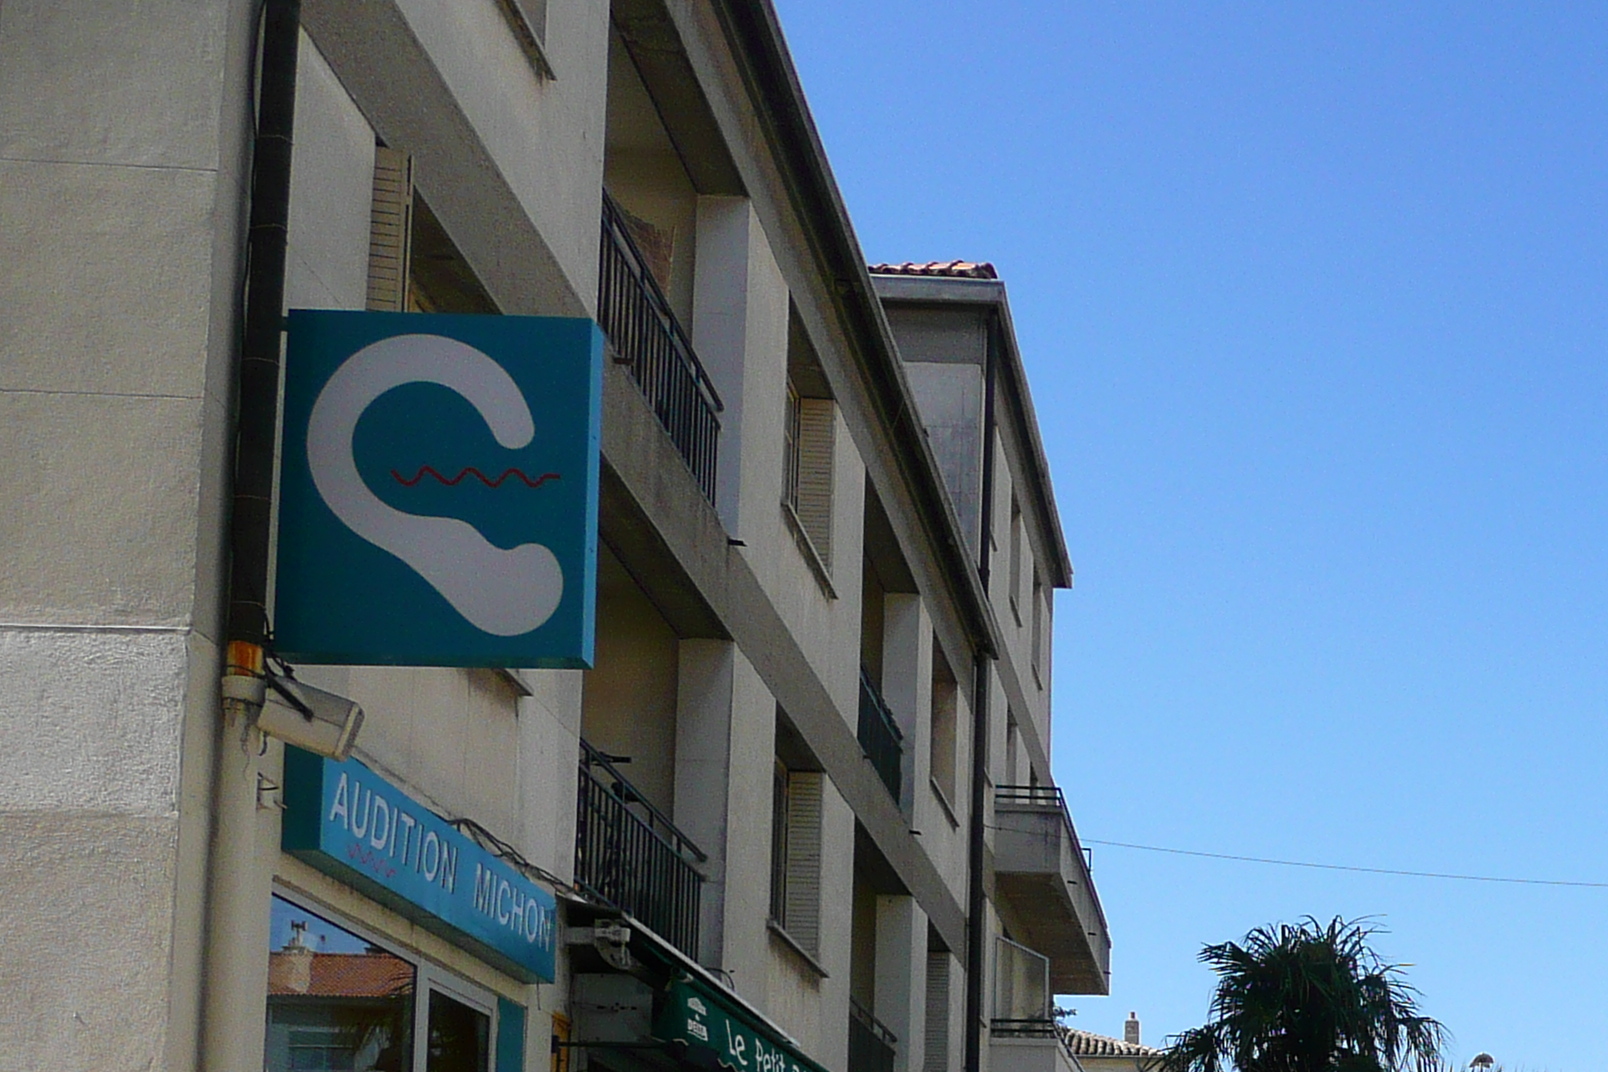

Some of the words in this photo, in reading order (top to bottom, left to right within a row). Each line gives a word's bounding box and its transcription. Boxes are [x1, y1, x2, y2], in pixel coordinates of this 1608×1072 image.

[330, 772, 458, 894] AUDITION
[473, 863, 552, 952] MICHON
[725, 1019, 748, 1066] Le
